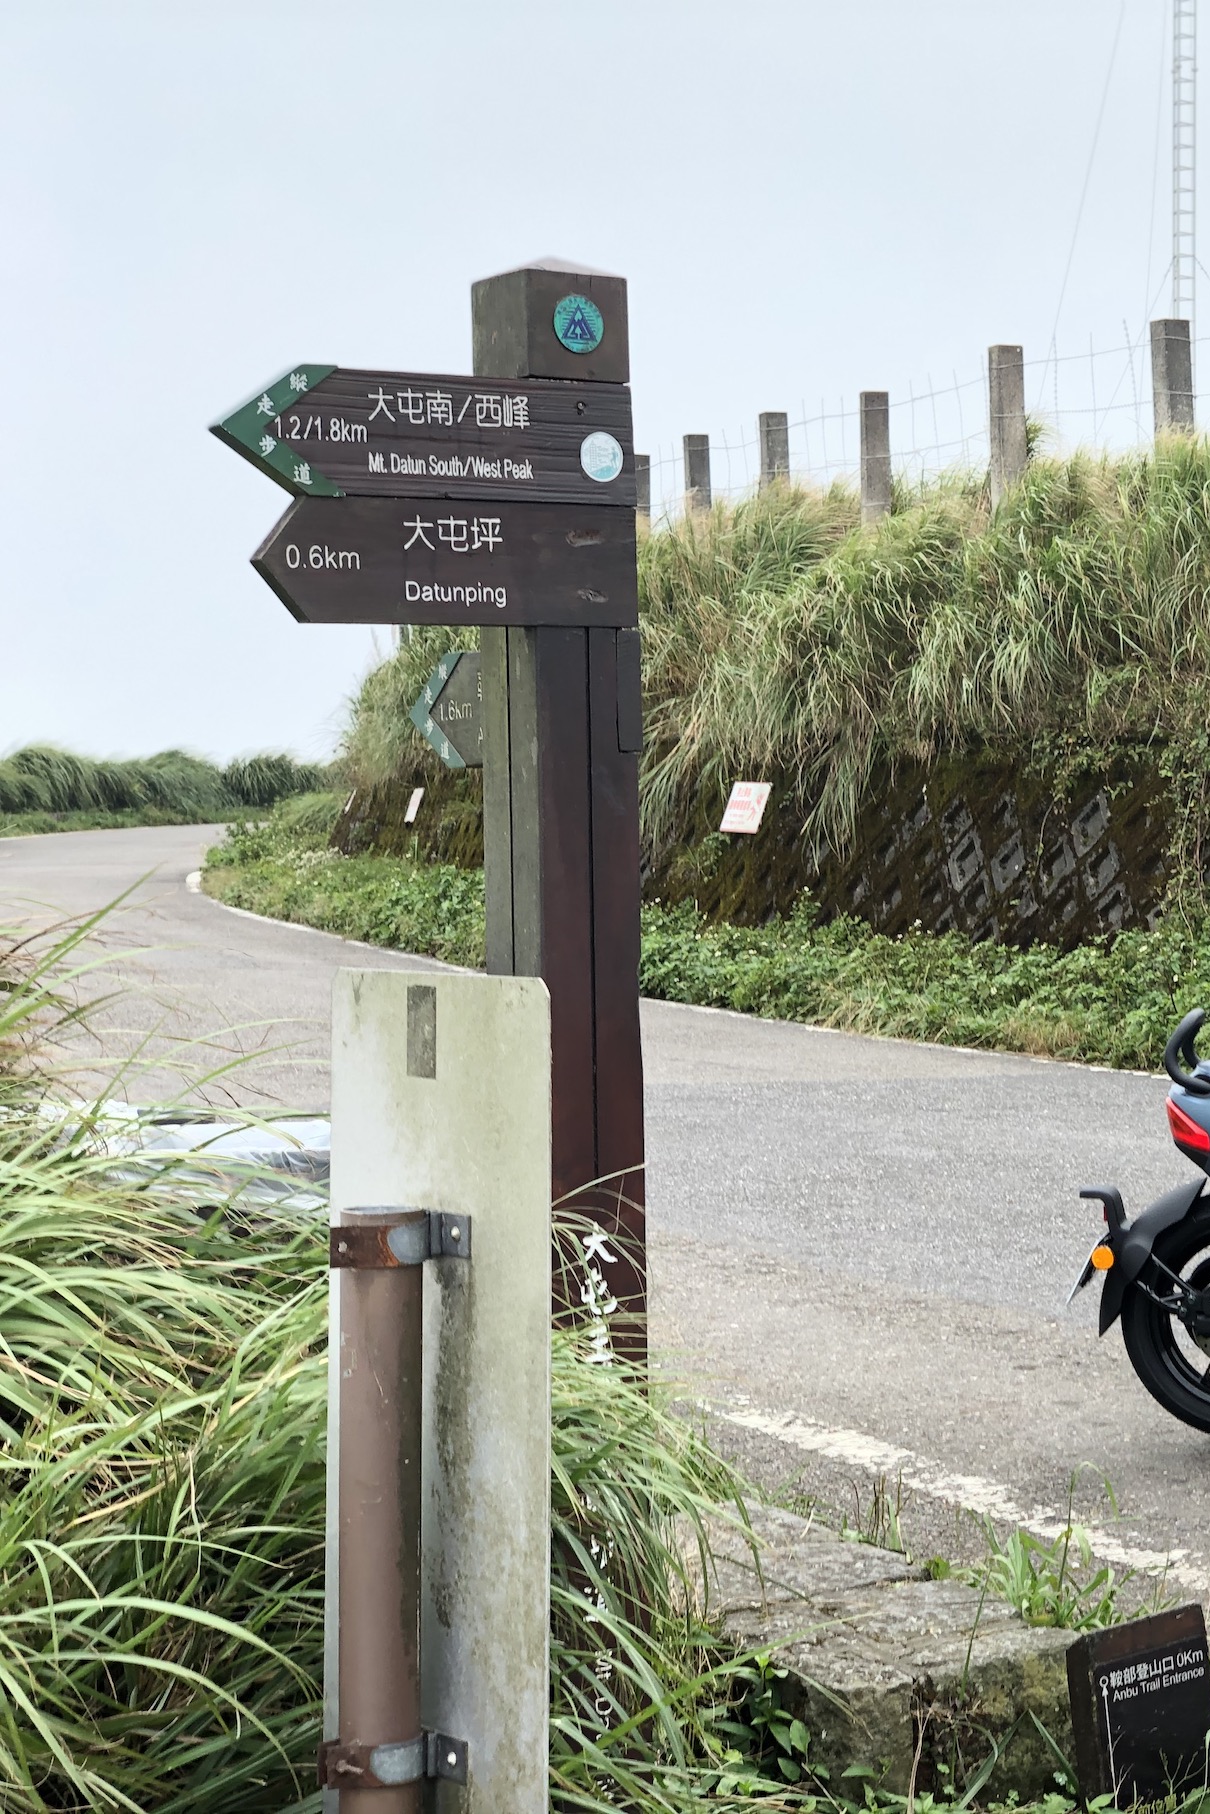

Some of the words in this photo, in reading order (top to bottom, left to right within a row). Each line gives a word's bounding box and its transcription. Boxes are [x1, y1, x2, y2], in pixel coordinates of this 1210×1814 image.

[368, 387, 530, 429] 大屯南/西峰
[274, 415, 368, 443] 1.2/1.8km
[368, 451, 388, 474] Mt.
[391, 453, 427, 475] Datun
[429, 455, 502, 479] South/West
[504, 459, 534, 480] Peak
[403, 514, 504, 552] 大屯坪
[285, 544, 361, 570] 0.6km
[405, 580, 507, 608] Datunping
[439, 699, 473, 721] 1.6km
[1109, 1655, 1174, 1689] 鞍部登山口
[1176, 1649, 1204, 1668] 0Km
[1113, 1685, 1139, 1702] Anbu
[1140, 1677, 1161, 1694] Trail
[1163, 1666, 1205, 1688] Entrance
